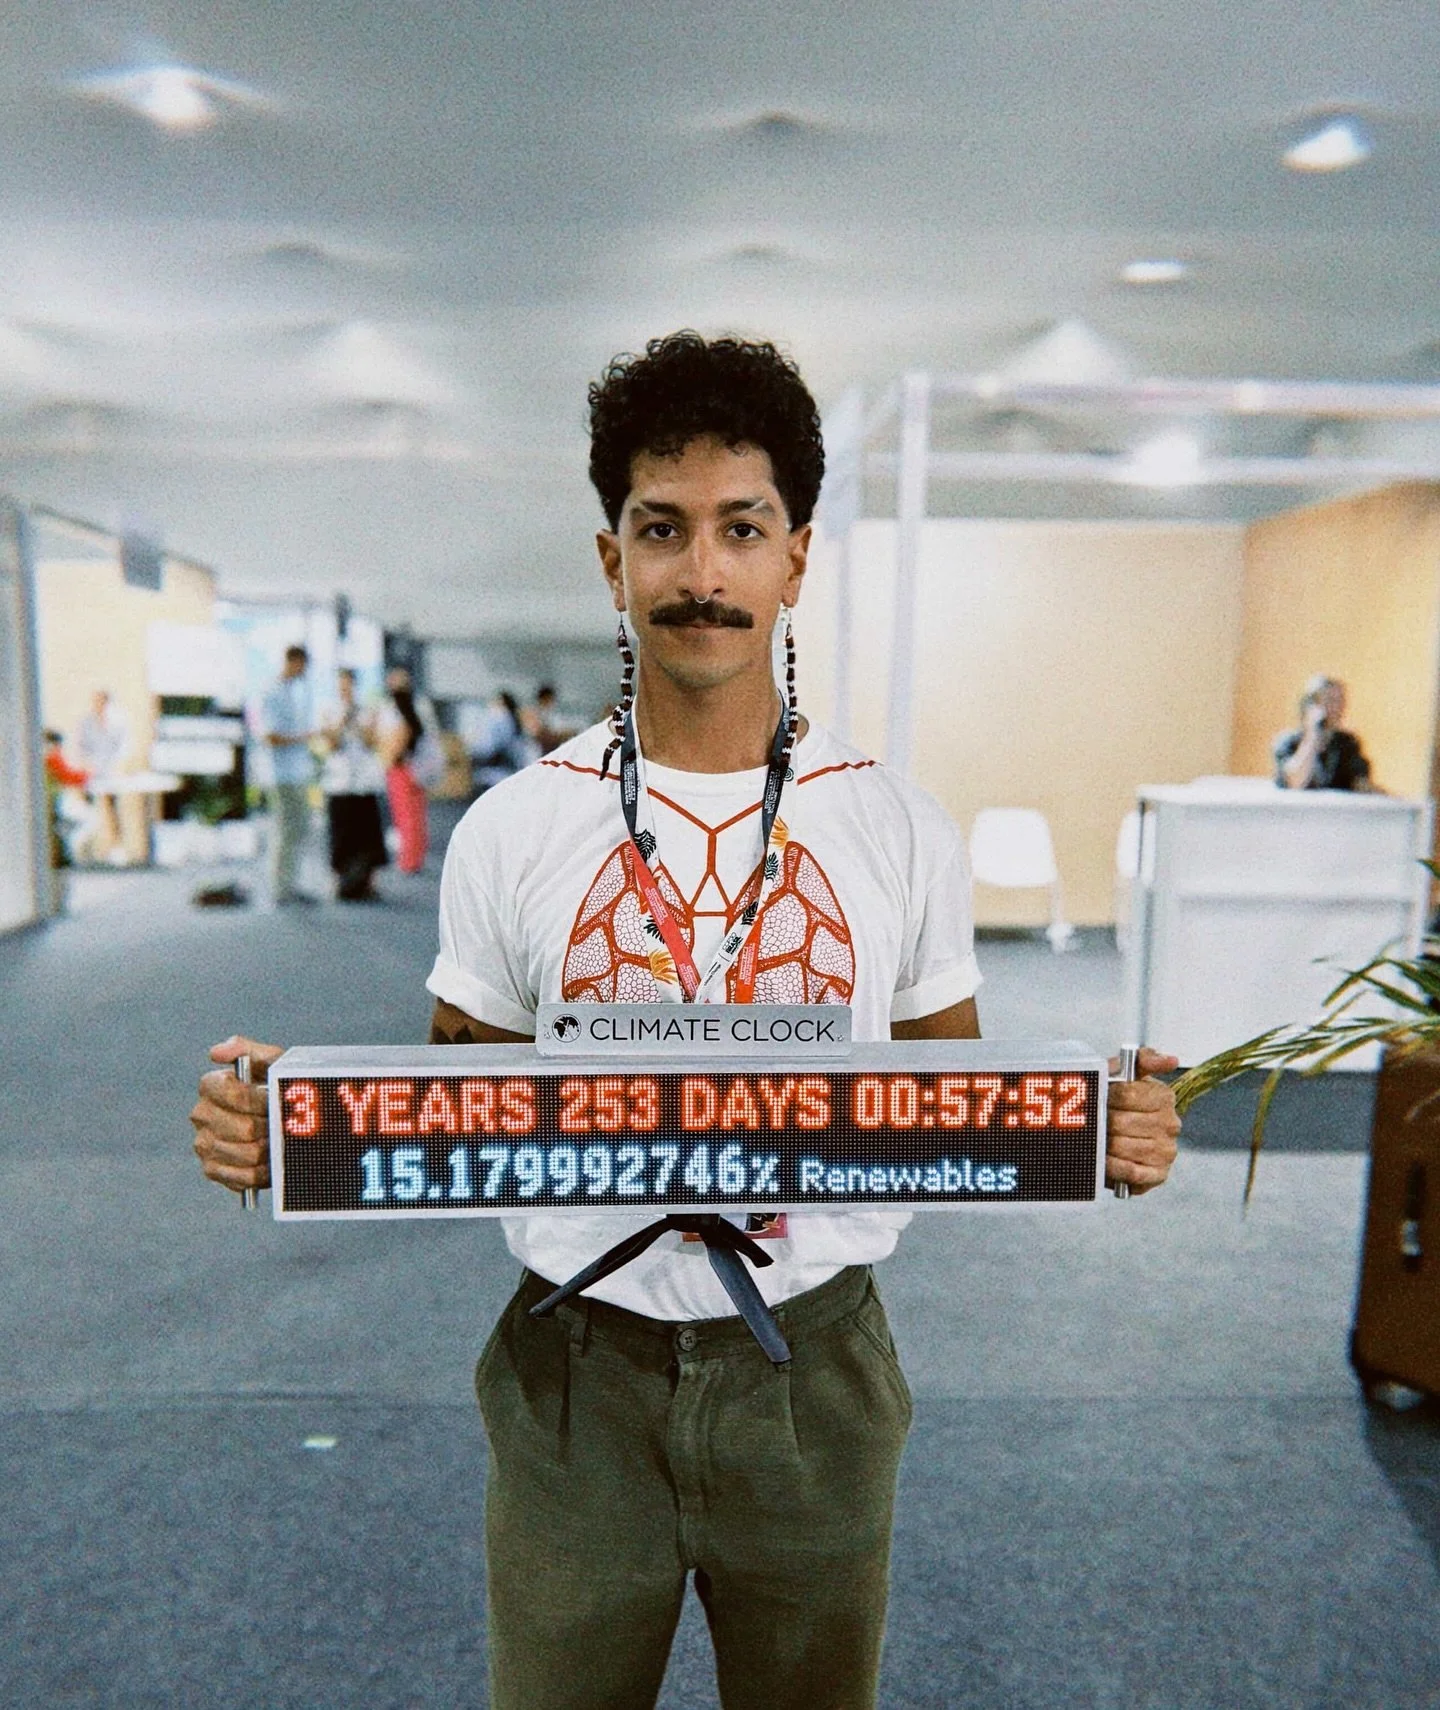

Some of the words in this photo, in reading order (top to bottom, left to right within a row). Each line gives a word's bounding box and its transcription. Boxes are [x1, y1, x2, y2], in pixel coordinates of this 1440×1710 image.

[589, 1018, 721, 1041] CLIMATE
[731, 1018, 836, 1042] CLOCK
[284, 1080, 319, 1136] 3
[337, 1078, 538, 1135] YEARS
[559, 1077, 661, 1133] 253
[680, 1075, 832, 1131] DAYS
[853, 1073, 1088, 1130] 00:57:52
[359, 1143, 779, 1201] 15.179992746%
[798, 1157, 1018, 1194] Renewables
